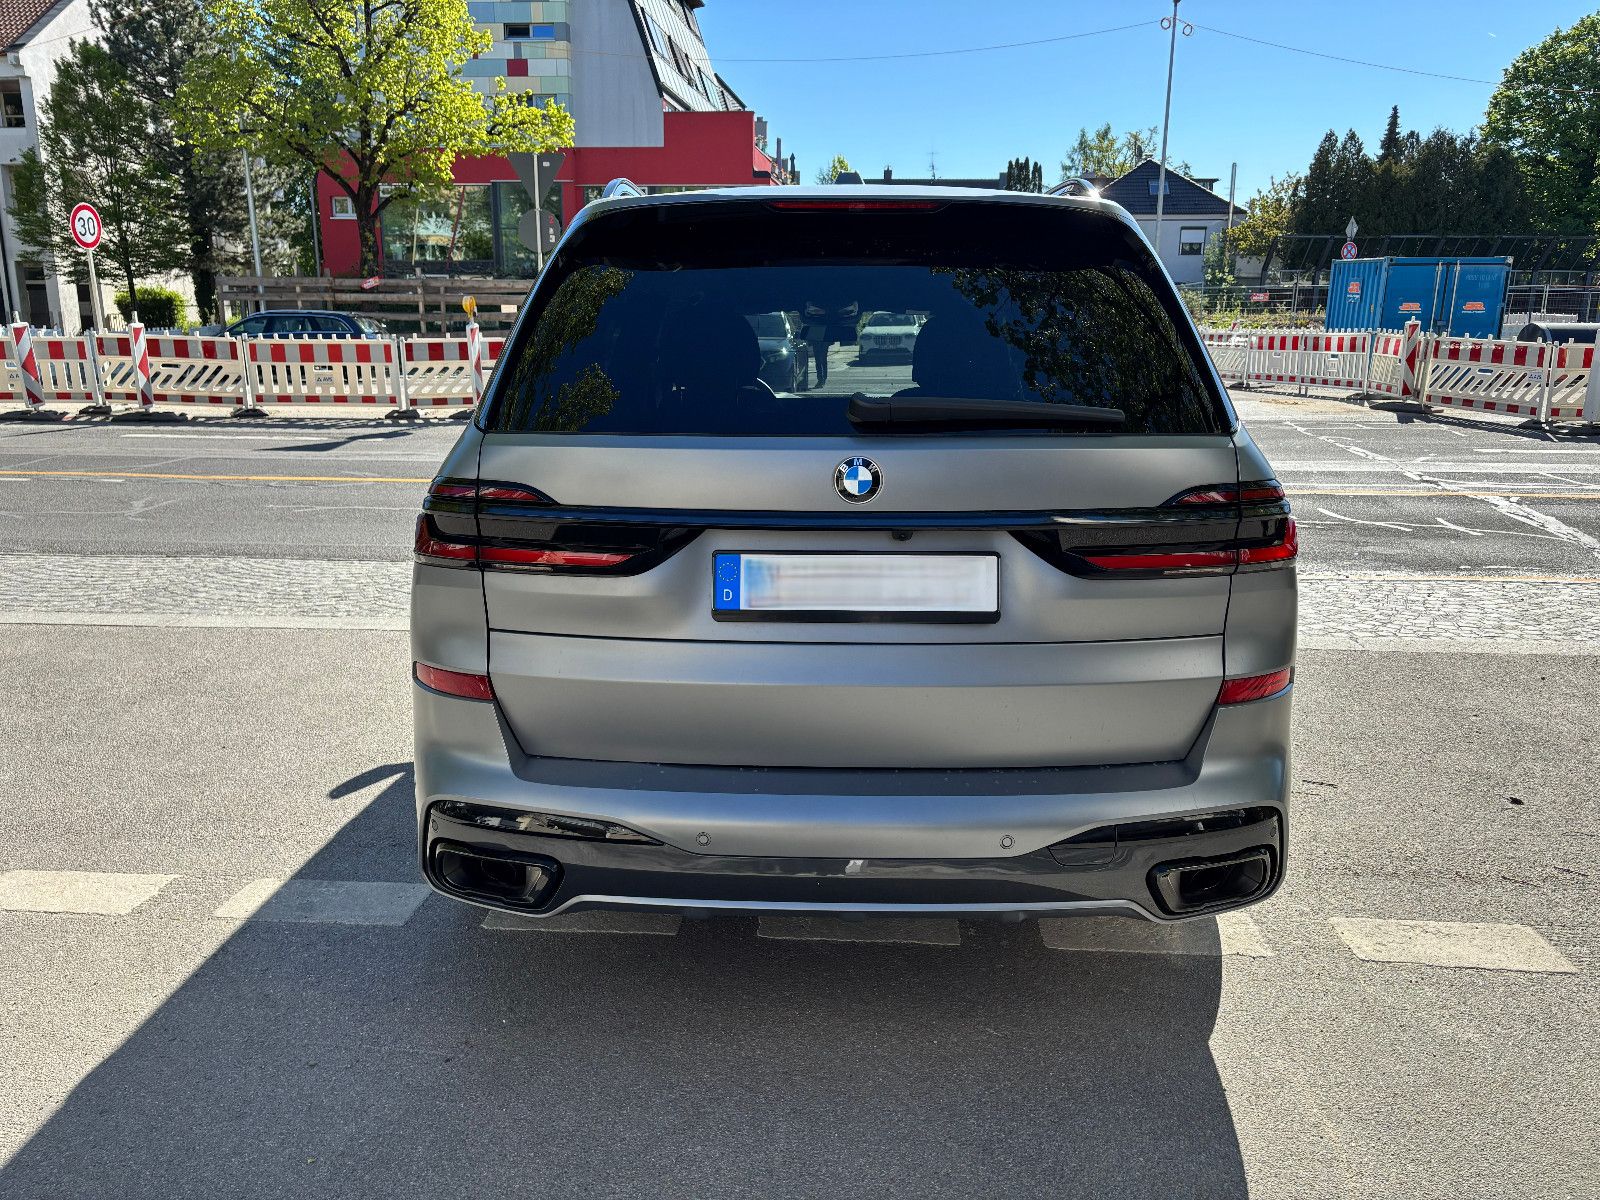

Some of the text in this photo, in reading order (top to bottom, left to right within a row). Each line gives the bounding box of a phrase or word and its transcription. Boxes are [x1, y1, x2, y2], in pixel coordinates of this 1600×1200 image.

[78, 216, 96, 236] 30
[840, 458, 878, 473] BMW
[723, 588, 733, 601] D
